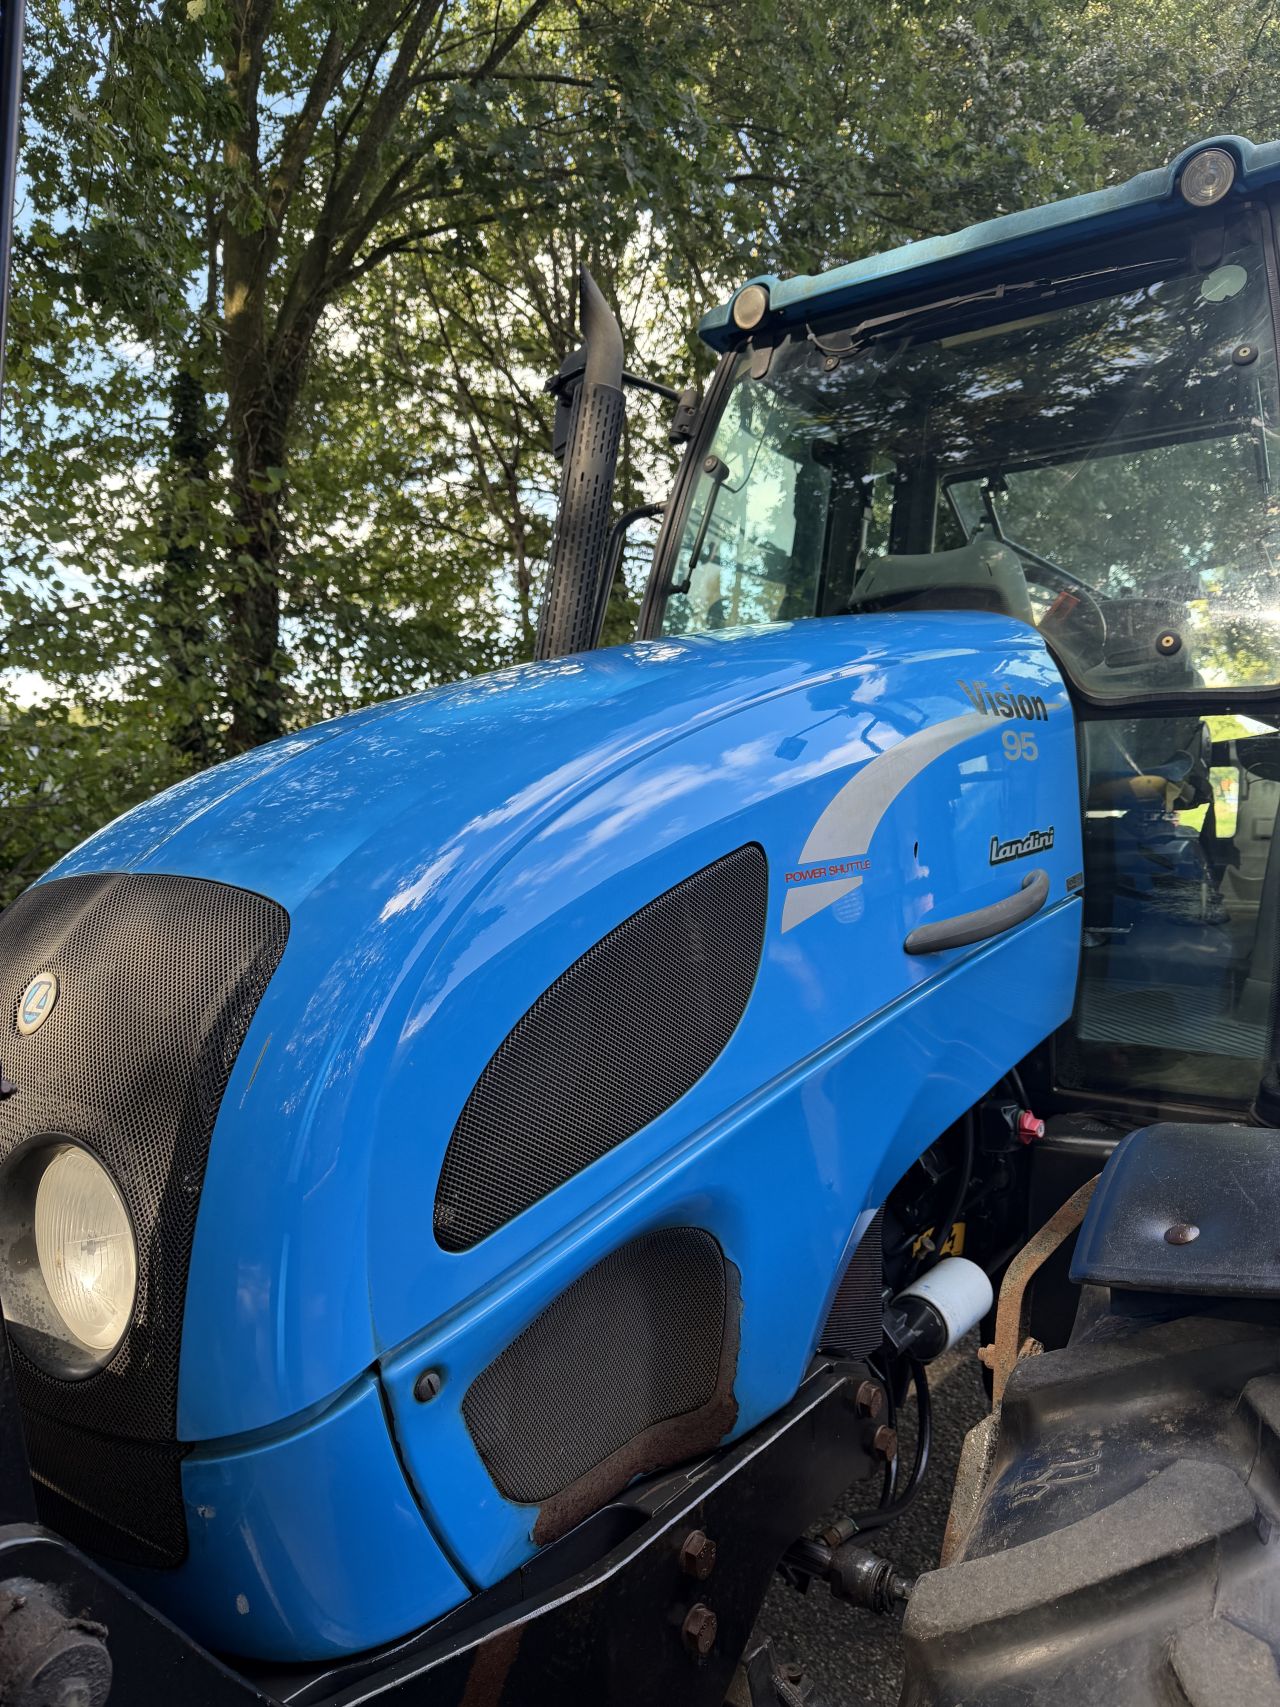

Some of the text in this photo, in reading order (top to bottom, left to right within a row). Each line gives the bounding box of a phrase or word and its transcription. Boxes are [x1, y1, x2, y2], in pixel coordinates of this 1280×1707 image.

[957, 679, 1048, 722] Vision
[1001, 730, 1039, 762] 95
[990, 827, 1054, 863] Landini
[784, 860, 871, 883] POWER SHUTTLE
